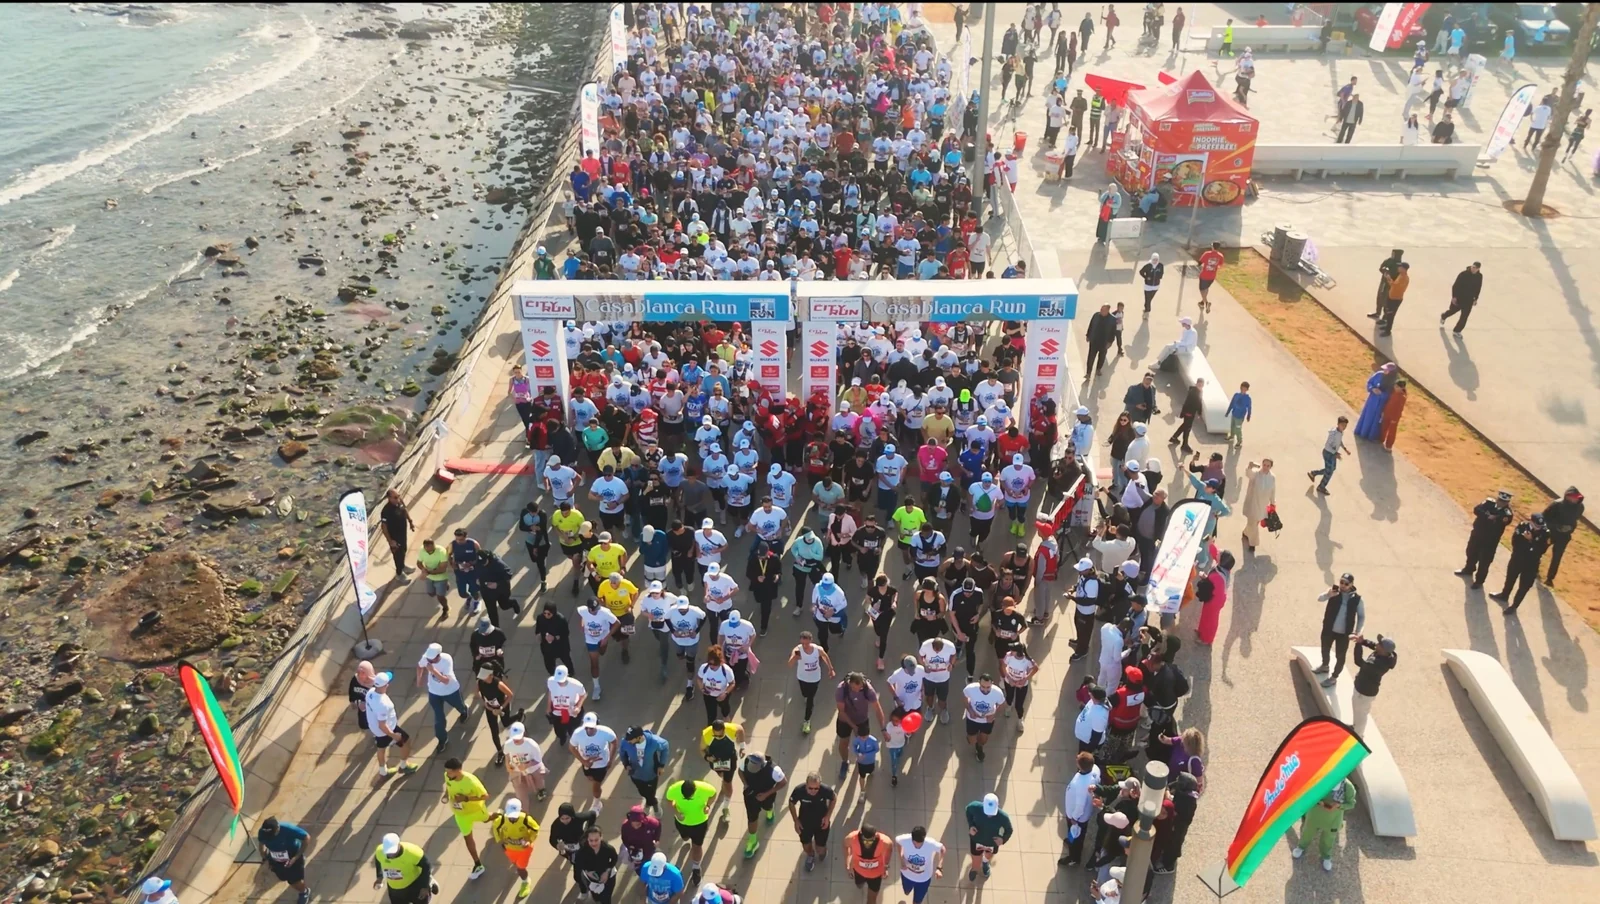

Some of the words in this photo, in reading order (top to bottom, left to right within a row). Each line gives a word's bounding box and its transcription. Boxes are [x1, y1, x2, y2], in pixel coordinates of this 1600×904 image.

[585, 299, 696, 314] Casablanca
[701, 300, 737, 315] Run
[873, 299, 984, 314] Casablanca
[989, 299, 1026, 314] Run
[1038, 308, 1064, 317] RUN
[750, 310, 775, 318] RUN
